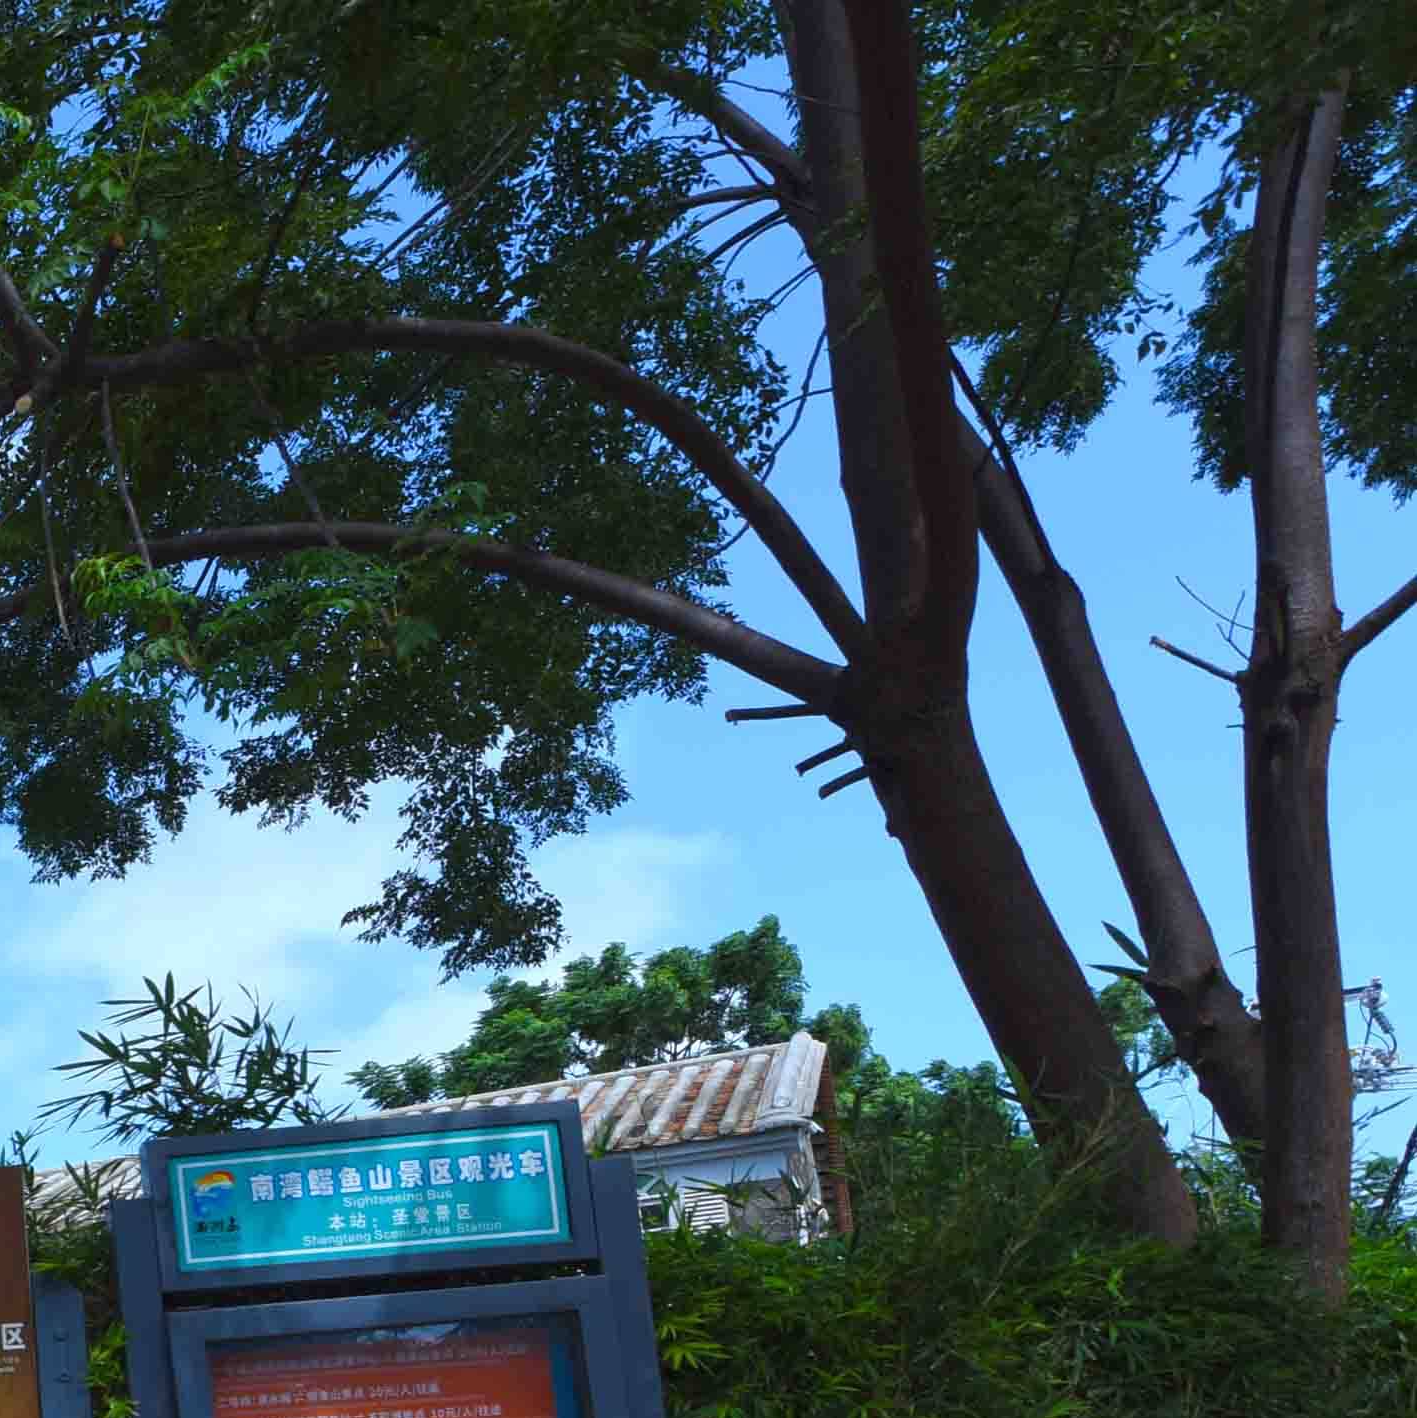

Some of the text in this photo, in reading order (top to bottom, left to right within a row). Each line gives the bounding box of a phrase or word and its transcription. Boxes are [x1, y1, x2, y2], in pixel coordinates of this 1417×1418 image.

[249, 1151, 546, 1203] 南湾鳄鱼山景区观光车
[343, 1188, 453, 1208] Sightseeing Bus
